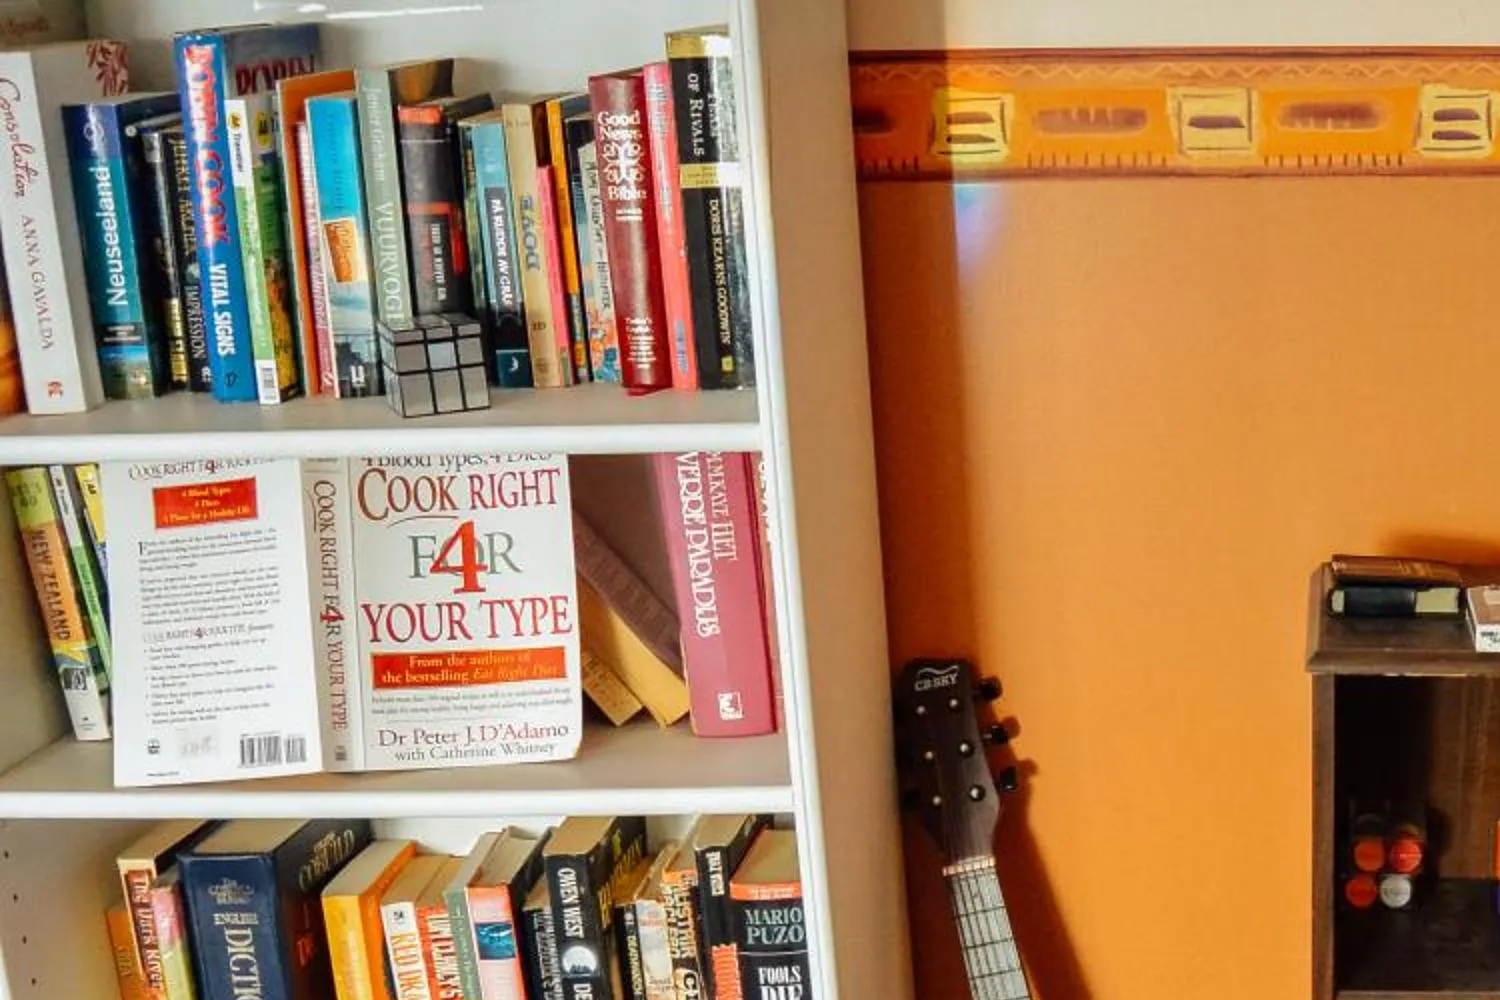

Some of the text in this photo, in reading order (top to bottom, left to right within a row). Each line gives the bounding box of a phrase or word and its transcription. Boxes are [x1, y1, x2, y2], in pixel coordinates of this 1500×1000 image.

[597, 111, 642, 128] Good
[688, 97, 706, 156] RIVALS
[194, 149, 231, 249] COOK
[608, 185, 648, 201] Bible
[88, 166, 129, 306] Neuseeland
[20, 214, 55, 351] ANNA GAVALDA
[374, 200, 405, 323] VUURVOGE
[210, 263, 236, 356] VITAL SIGNS
[714, 288, 731, 345] GOODWIN
[357, 467, 560, 520] COOK RIGHT
[712, 520, 738, 561] HET
[31, 529, 71, 641] NEW ZEALAND
[313, 480, 348, 730] COOK RIGHT YOUR TYPE
[360, 596, 573, 644] YOUR TYPE
[381, 671, 402, 682] the
[405, 669, 470, 684] bestselling
[409, 656, 443, 668] From
[447, 654, 467, 665] the
[378, 729, 406, 746] Dr
[413, 727, 459, 746] Peter
[479, 722, 569, 742] D'Adamo
[395, 742, 557, 762] with Catherine Whitney
[558, 867, 585, 939] OWEN WEST
[745, 906, 803, 926] MARIO
[390, 931, 421, 967] RED
[746, 922, 804, 945] PUZO
[757, 965, 802, 985] FOOLS
